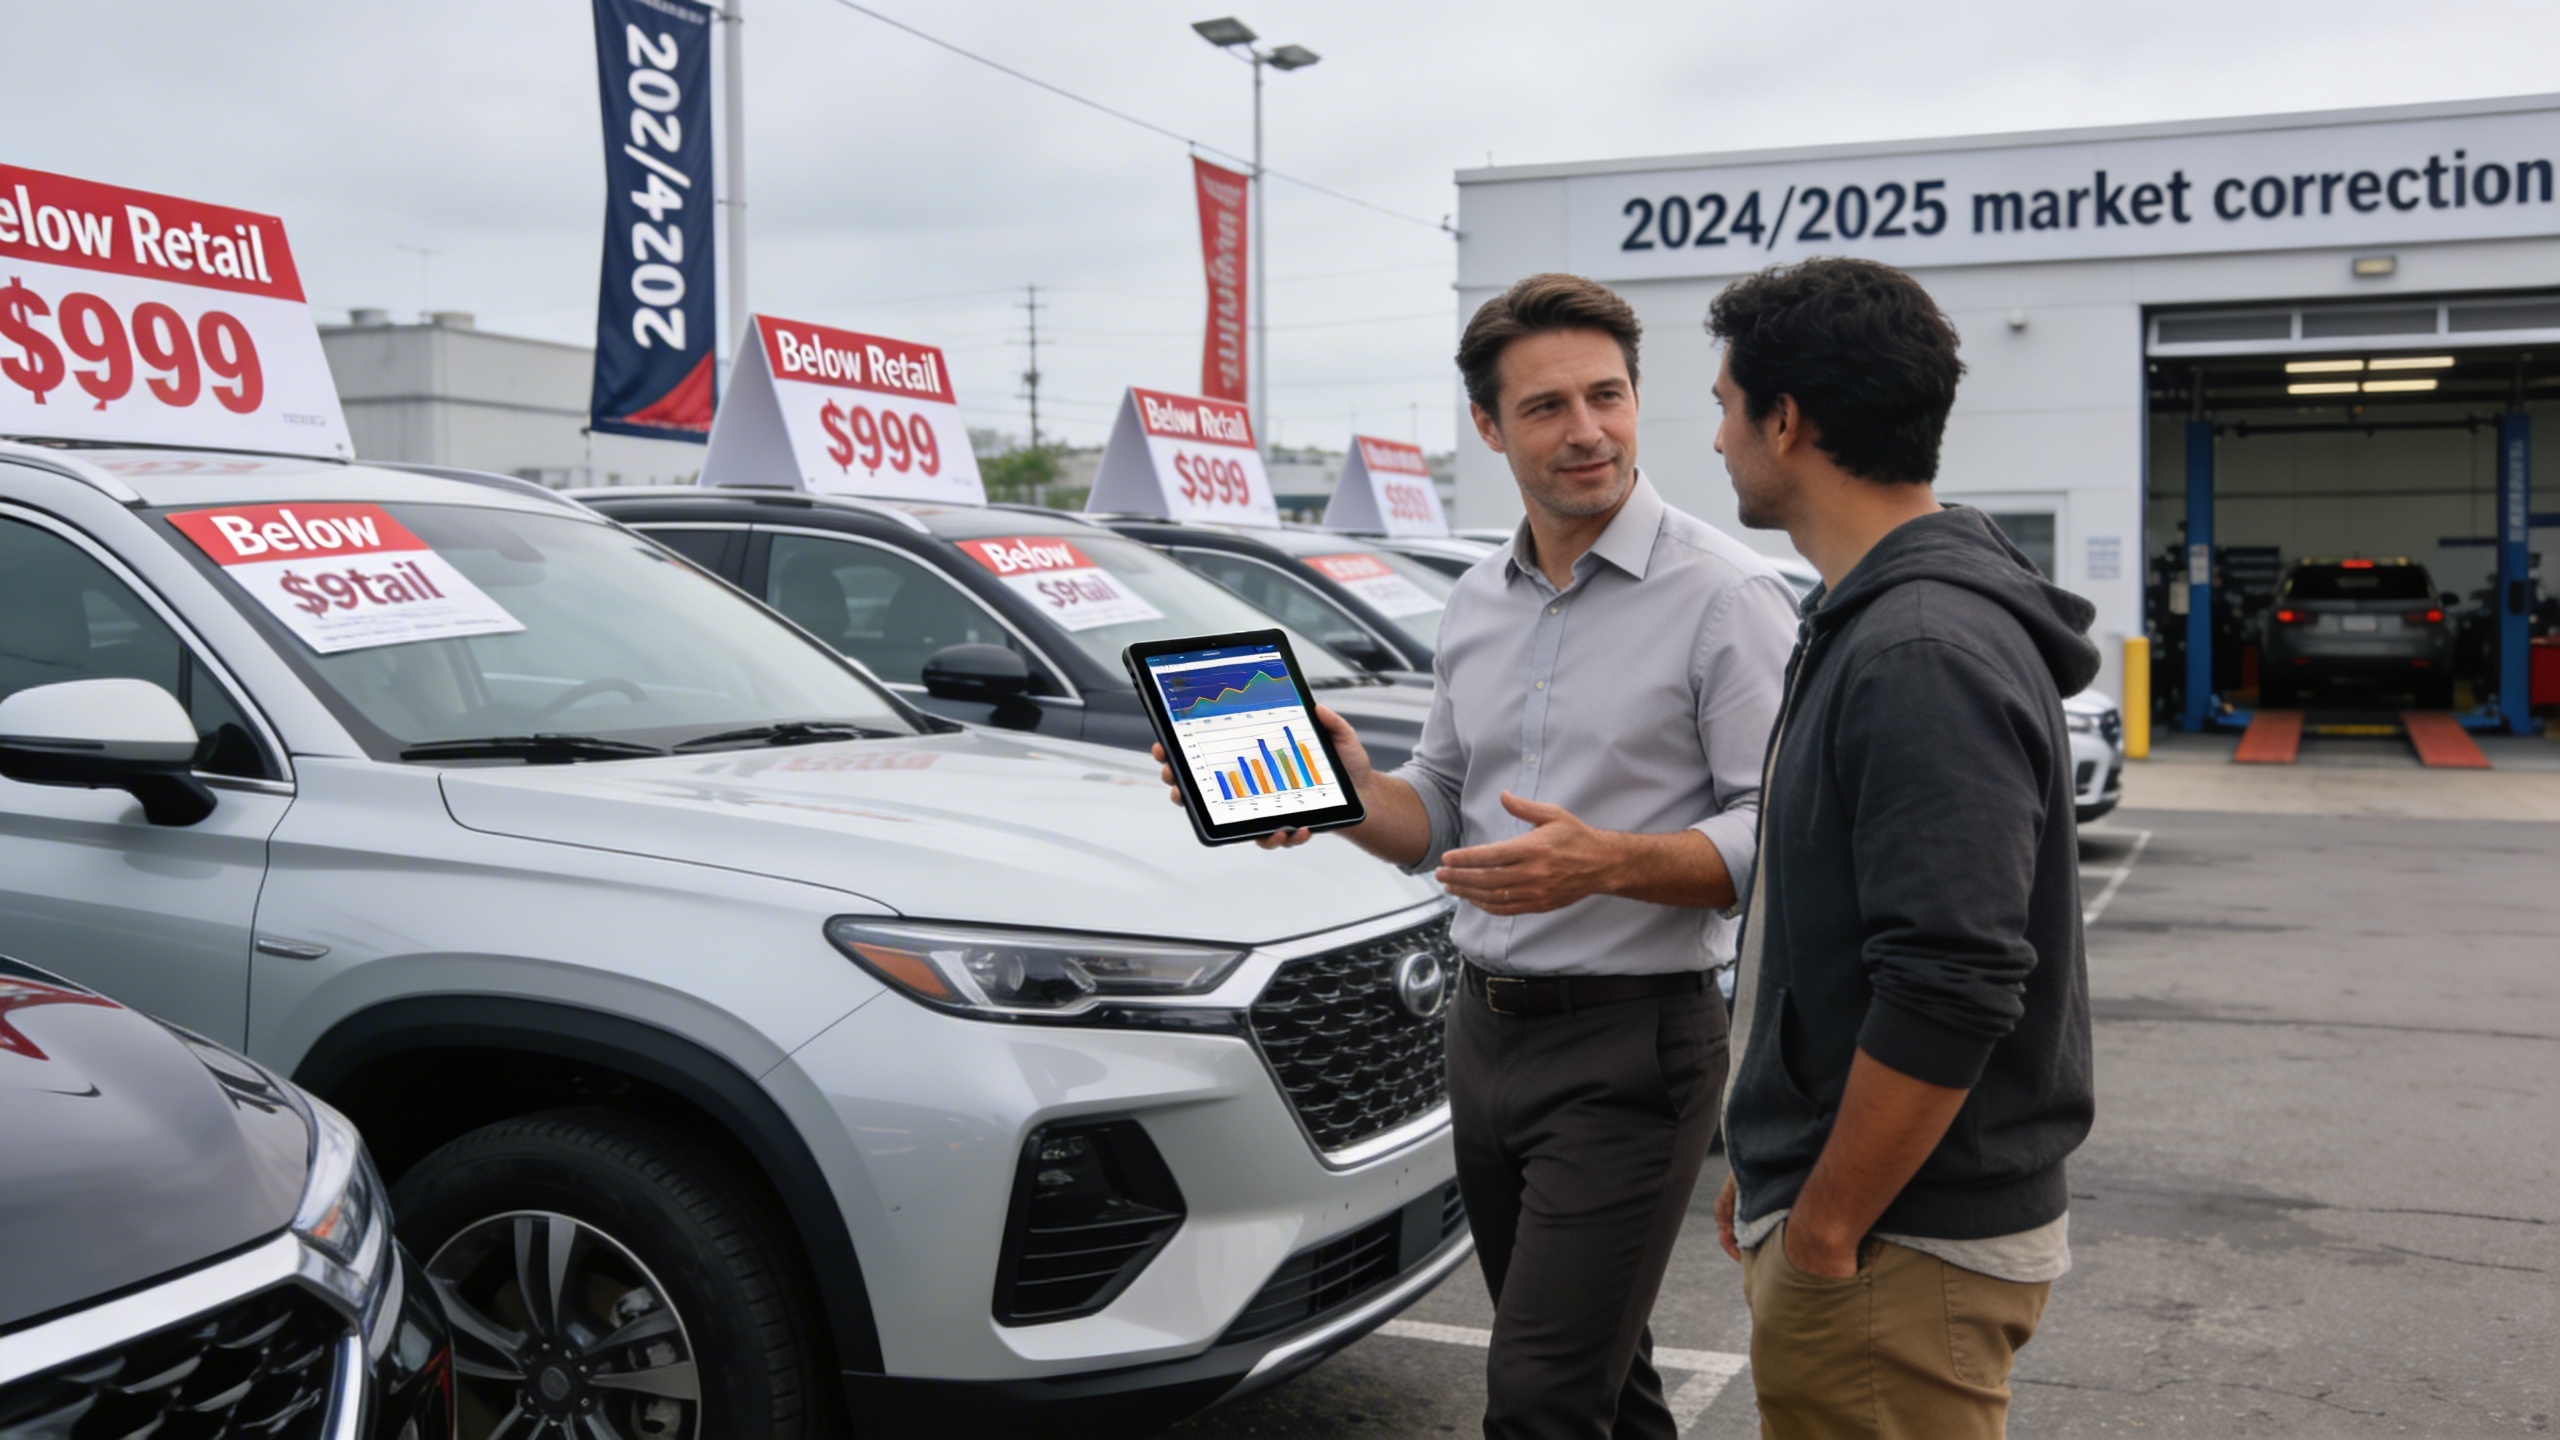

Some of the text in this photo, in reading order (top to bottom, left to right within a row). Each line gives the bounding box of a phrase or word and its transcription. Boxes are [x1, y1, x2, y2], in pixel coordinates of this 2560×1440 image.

[1620, 148, 2554, 251] 2024/2025 market correction
[124, 203, 273, 284] Retail
[0, 275, 265, 415] $999
[774, 328, 942, 394] Below Retail
[819, 398, 941, 478] $999
[1173, 449, 1250, 507] $999
[209, 508, 382, 556] Below
[979, 538, 1076, 573] Below
